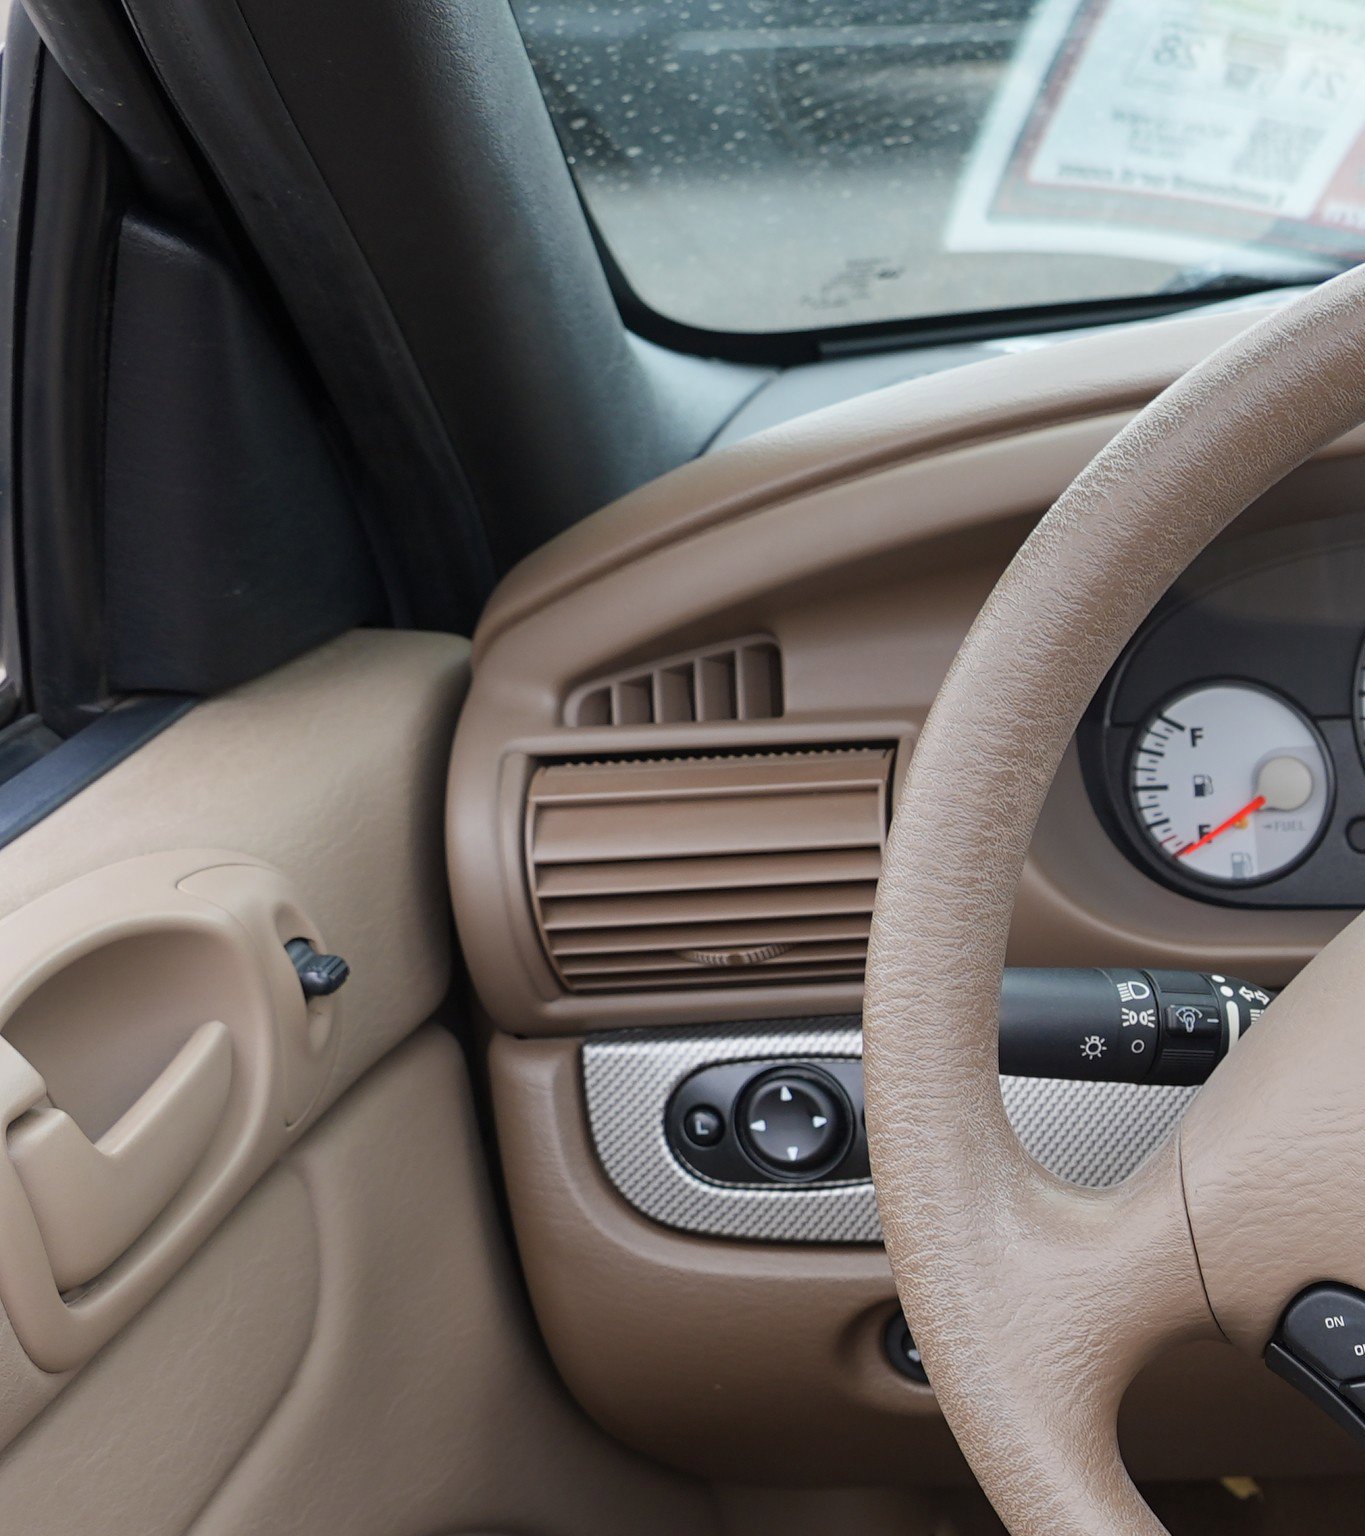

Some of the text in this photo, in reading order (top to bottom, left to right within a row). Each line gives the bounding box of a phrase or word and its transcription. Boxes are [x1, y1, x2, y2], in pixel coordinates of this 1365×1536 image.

[1190, 727, 1205, 748] F
[1198, 824, 1212, 845] E
[1273, 820, 1307, 833] FUEL
[695, 1119, 708, 1135] L
[1324, 1315, 1345, 1329] ON
